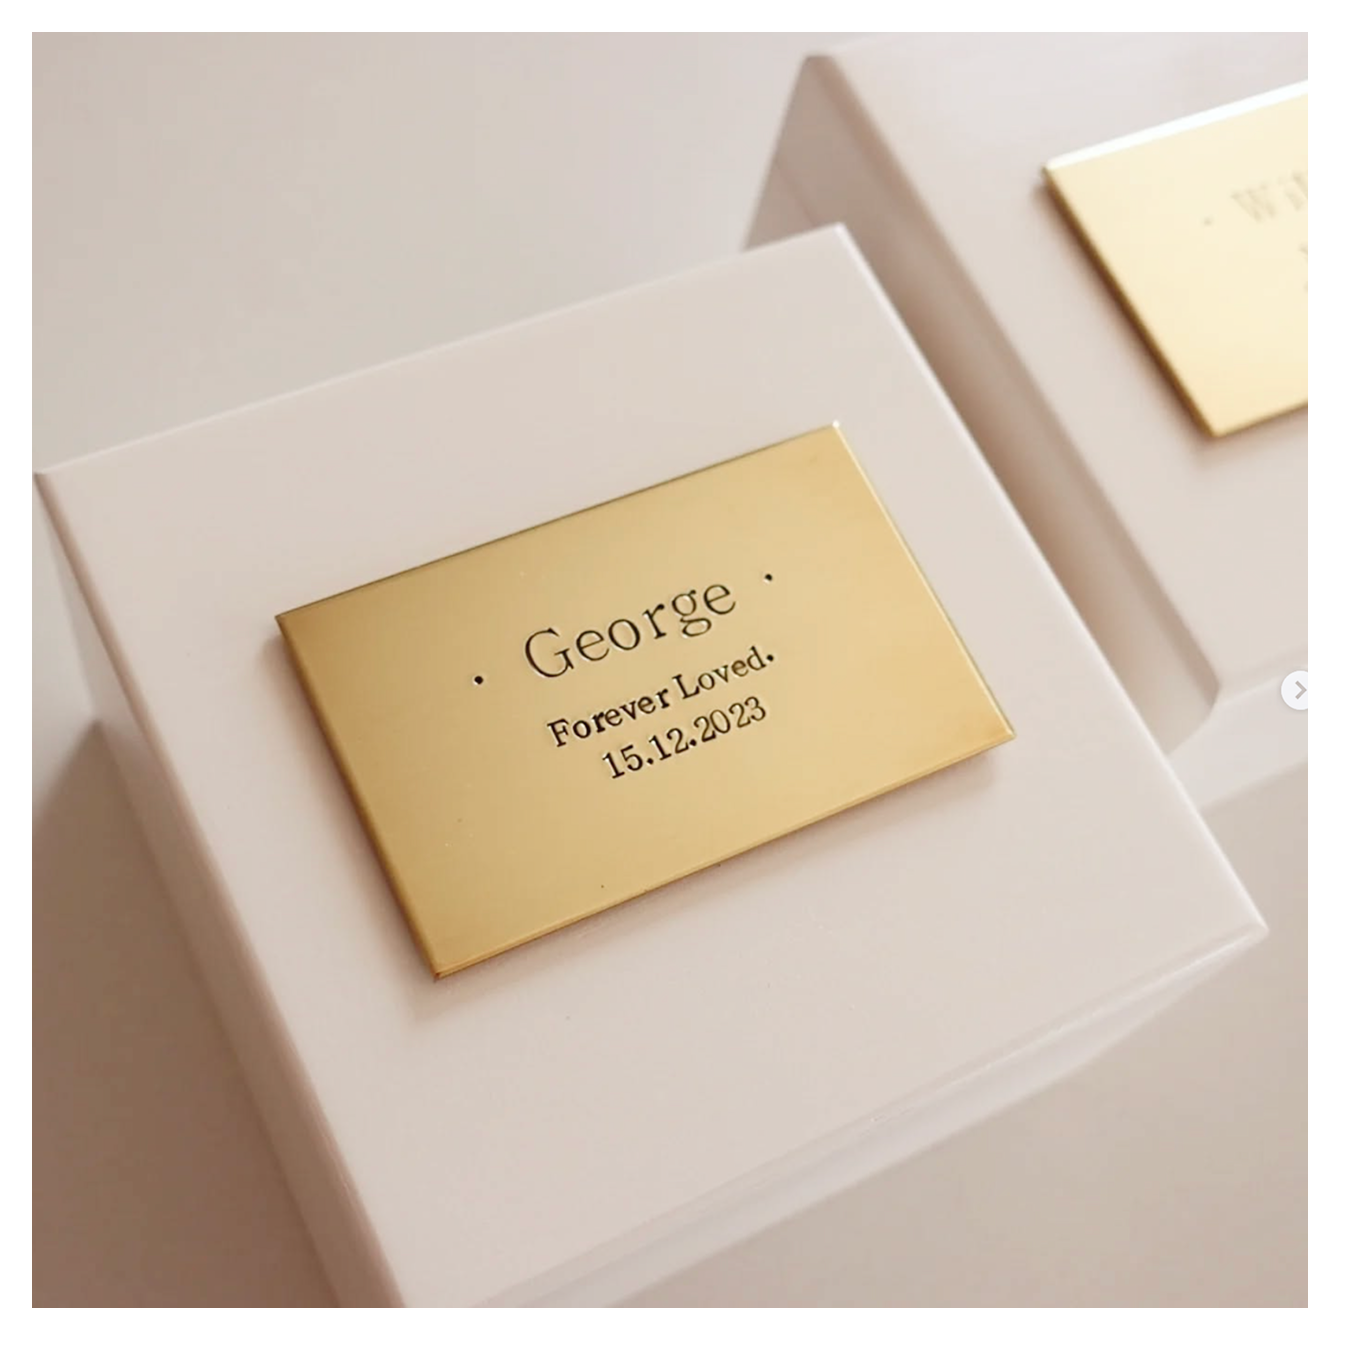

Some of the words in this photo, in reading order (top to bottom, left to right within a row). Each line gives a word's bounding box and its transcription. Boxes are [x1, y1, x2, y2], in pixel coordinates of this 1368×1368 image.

[524, 583, 737, 679] George
[546, 687, 670, 748] Forever
[671, 644, 775, 700] Loved.
[601, 695, 767, 780] 15.12.2023
